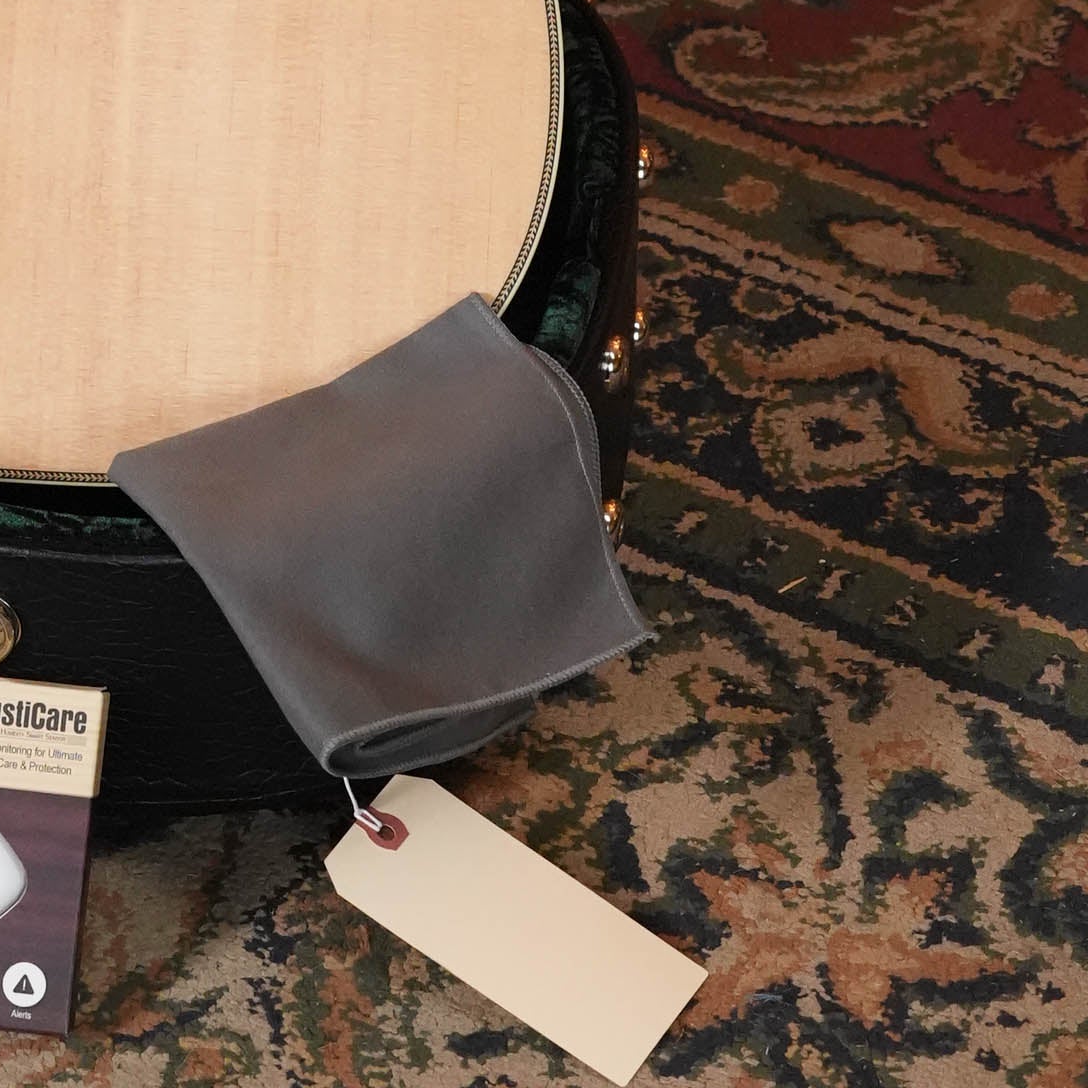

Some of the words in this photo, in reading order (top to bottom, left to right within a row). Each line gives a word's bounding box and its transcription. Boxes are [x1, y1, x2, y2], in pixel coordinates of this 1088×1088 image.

[34, 746, 46, 758] for
[47, 748, 84, 762] Ultimate
[19, 761, 27, 771] &
[28, 761, 72, 776] Protection
[10, 1009, 32, 1020] Alerts
